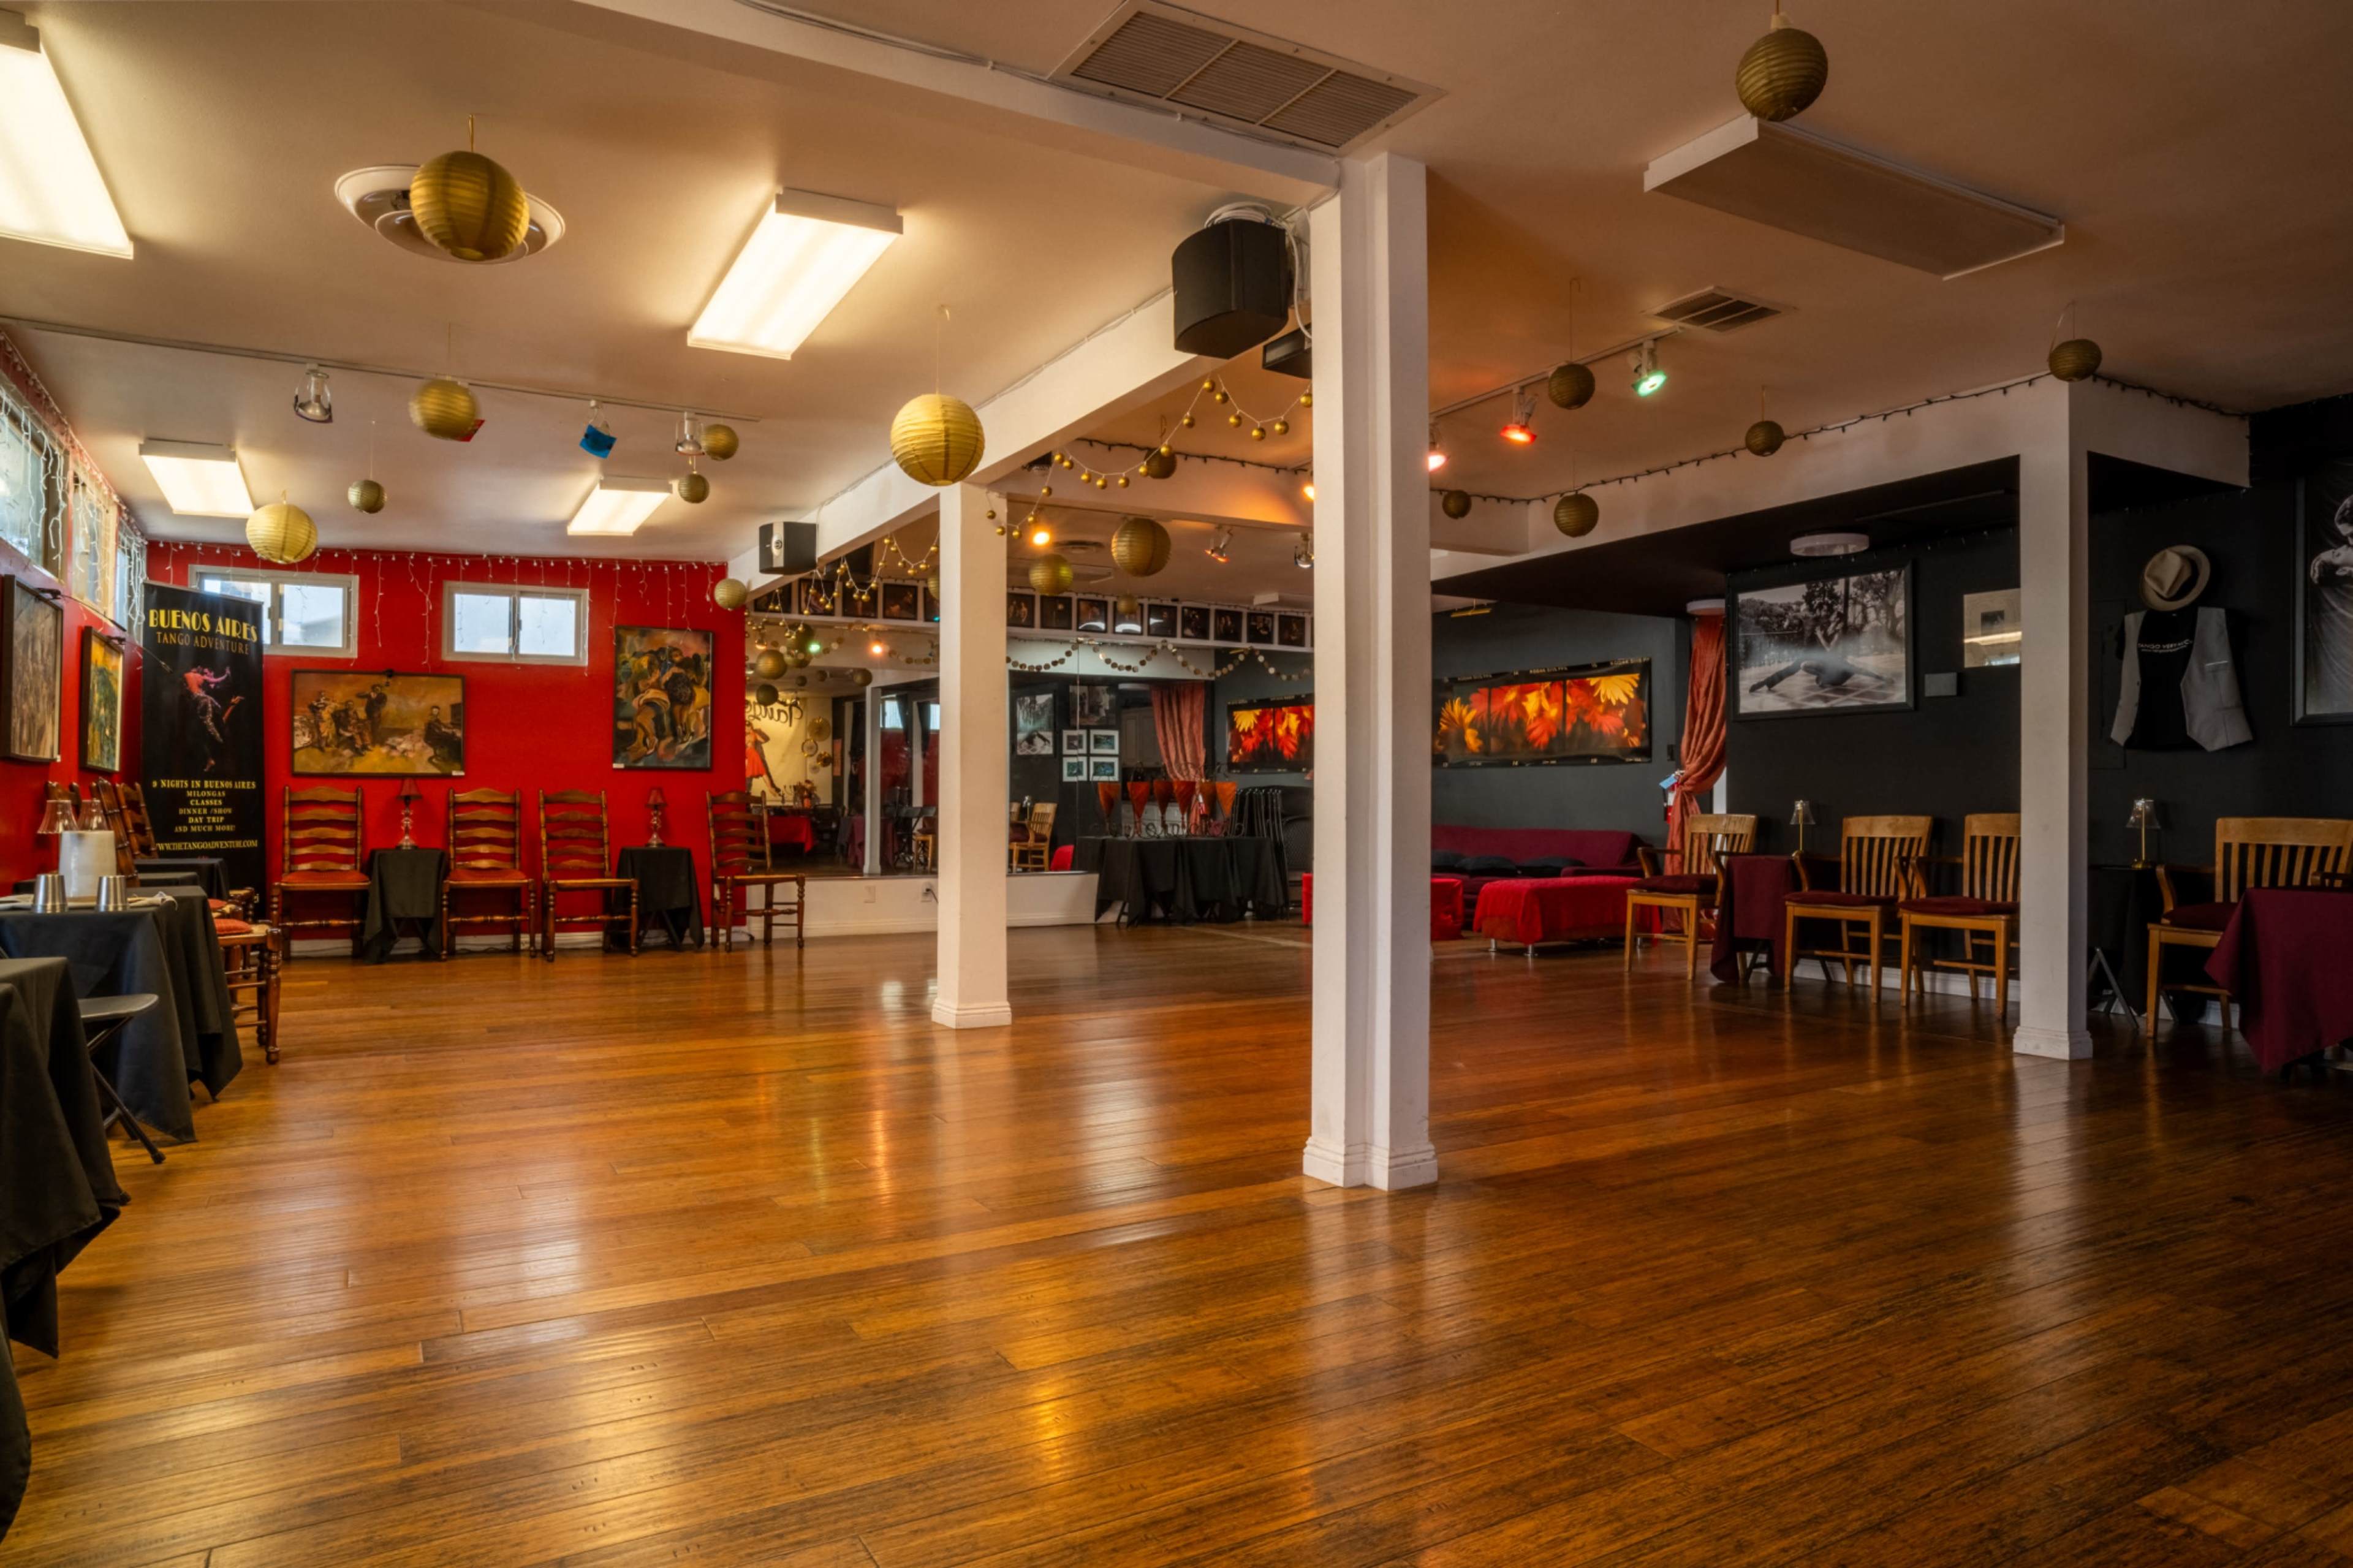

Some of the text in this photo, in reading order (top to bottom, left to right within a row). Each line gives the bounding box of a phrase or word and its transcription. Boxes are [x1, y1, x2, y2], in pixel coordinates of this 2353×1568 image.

[149, 609, 258, 643] BUENOS AIRES
[156, 632, 249, 654] TANGO ADVENTURE
[161, 779, 188, 789] NIGHTS
[204, 780, 233, 789] BUENOS
